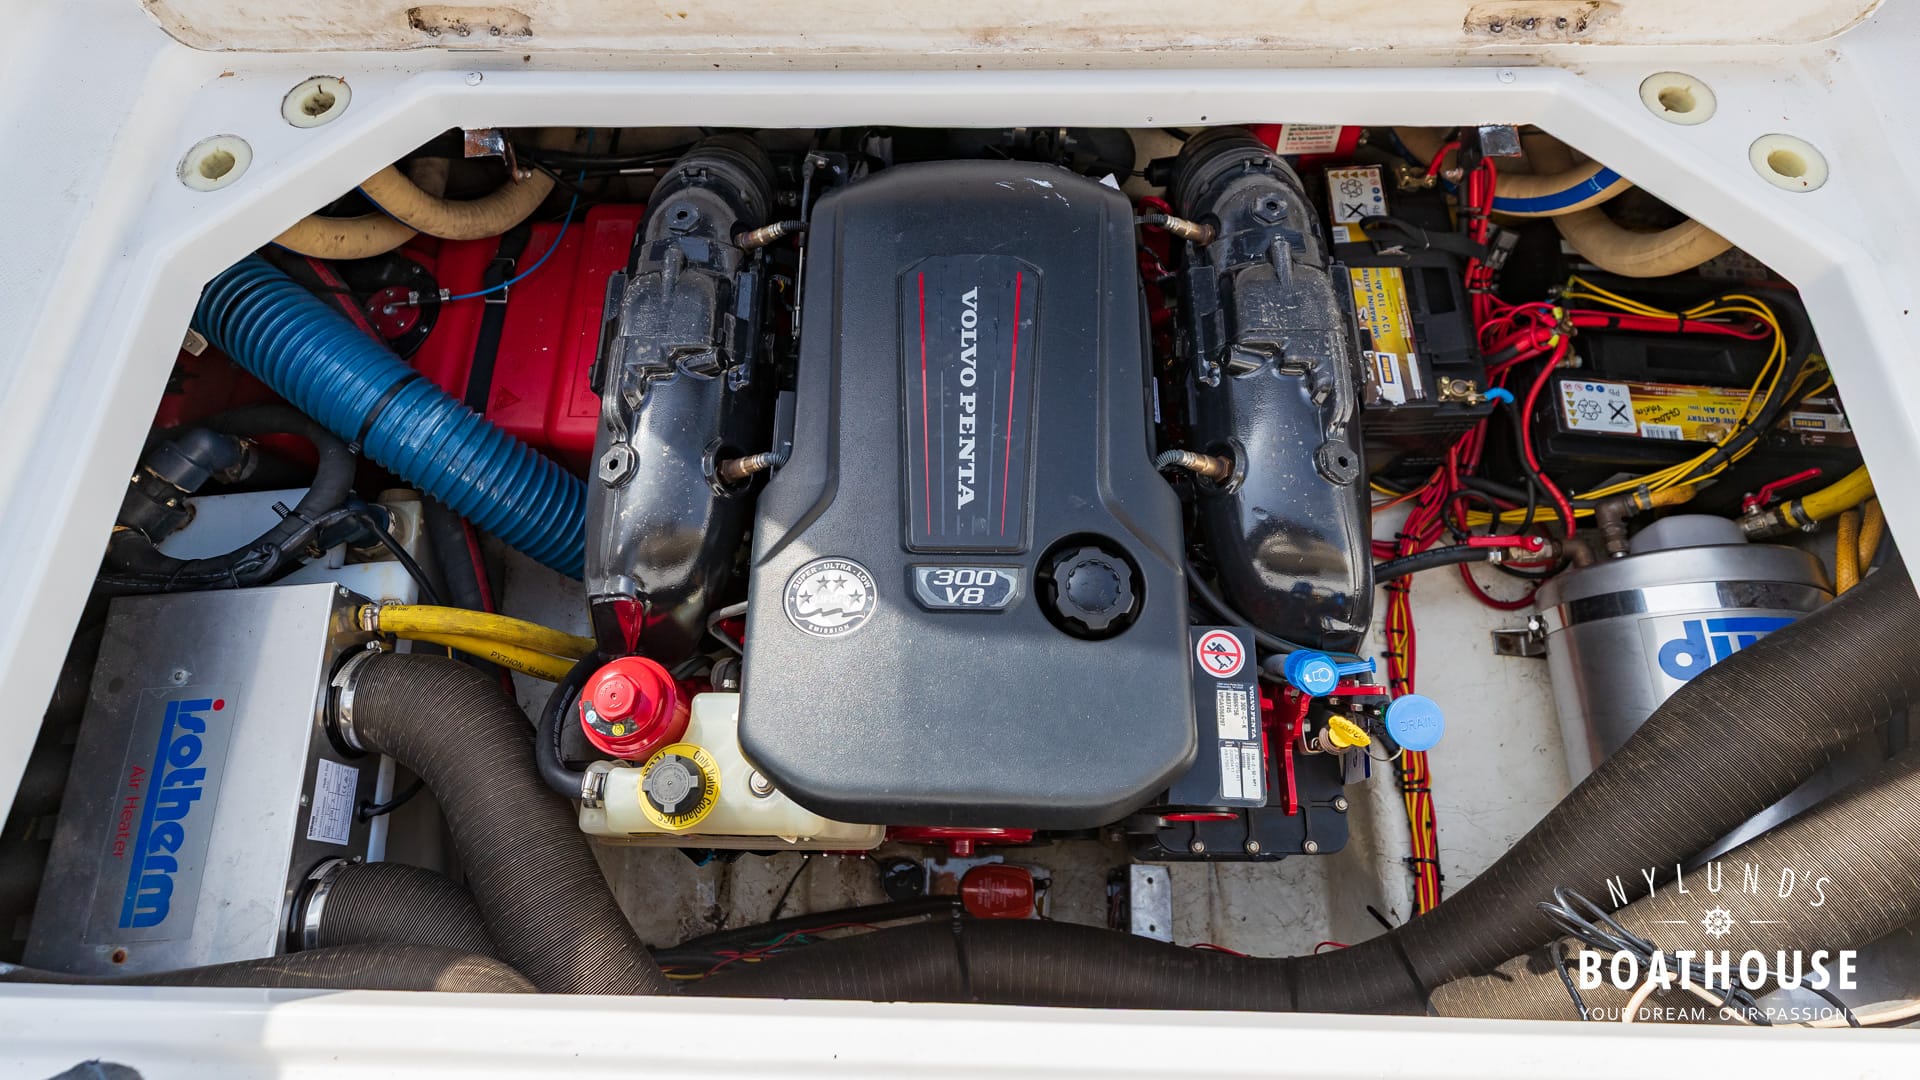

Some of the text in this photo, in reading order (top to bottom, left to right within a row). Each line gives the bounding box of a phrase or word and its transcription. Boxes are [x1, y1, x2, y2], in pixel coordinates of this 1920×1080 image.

[1362, 269, 1373, 292] BATTER
[1375, 280, 1382, 290] Ah
[1367, 295, 1379, 323] MARINE
[1377, 293, 1386, 307] 110
[1383, 323, 1391, 334] 12
[957, 287, 979, 510] VOLVO PENTA
[1687, 415, 1721, 423] BATTERY
[792, 567, 818, 589] SUPER
[823, 562, 851, 572] ULTRA
[856, 572, 872, 588] LOW
[933, 569, 996, 586] 300
[945, 587, 985, 604] V8
[807, 623, 850, 634] EMISSION
[490, 650, 524, 669] PYTHON
[692, 750, 710, 768] Only
[705, 769, 717, 796] Volvo
[112, 766, 146, 860] Air Heater
[132, 699, 225, 929] isotherm
[680, 798, 712, 824] Coolant
